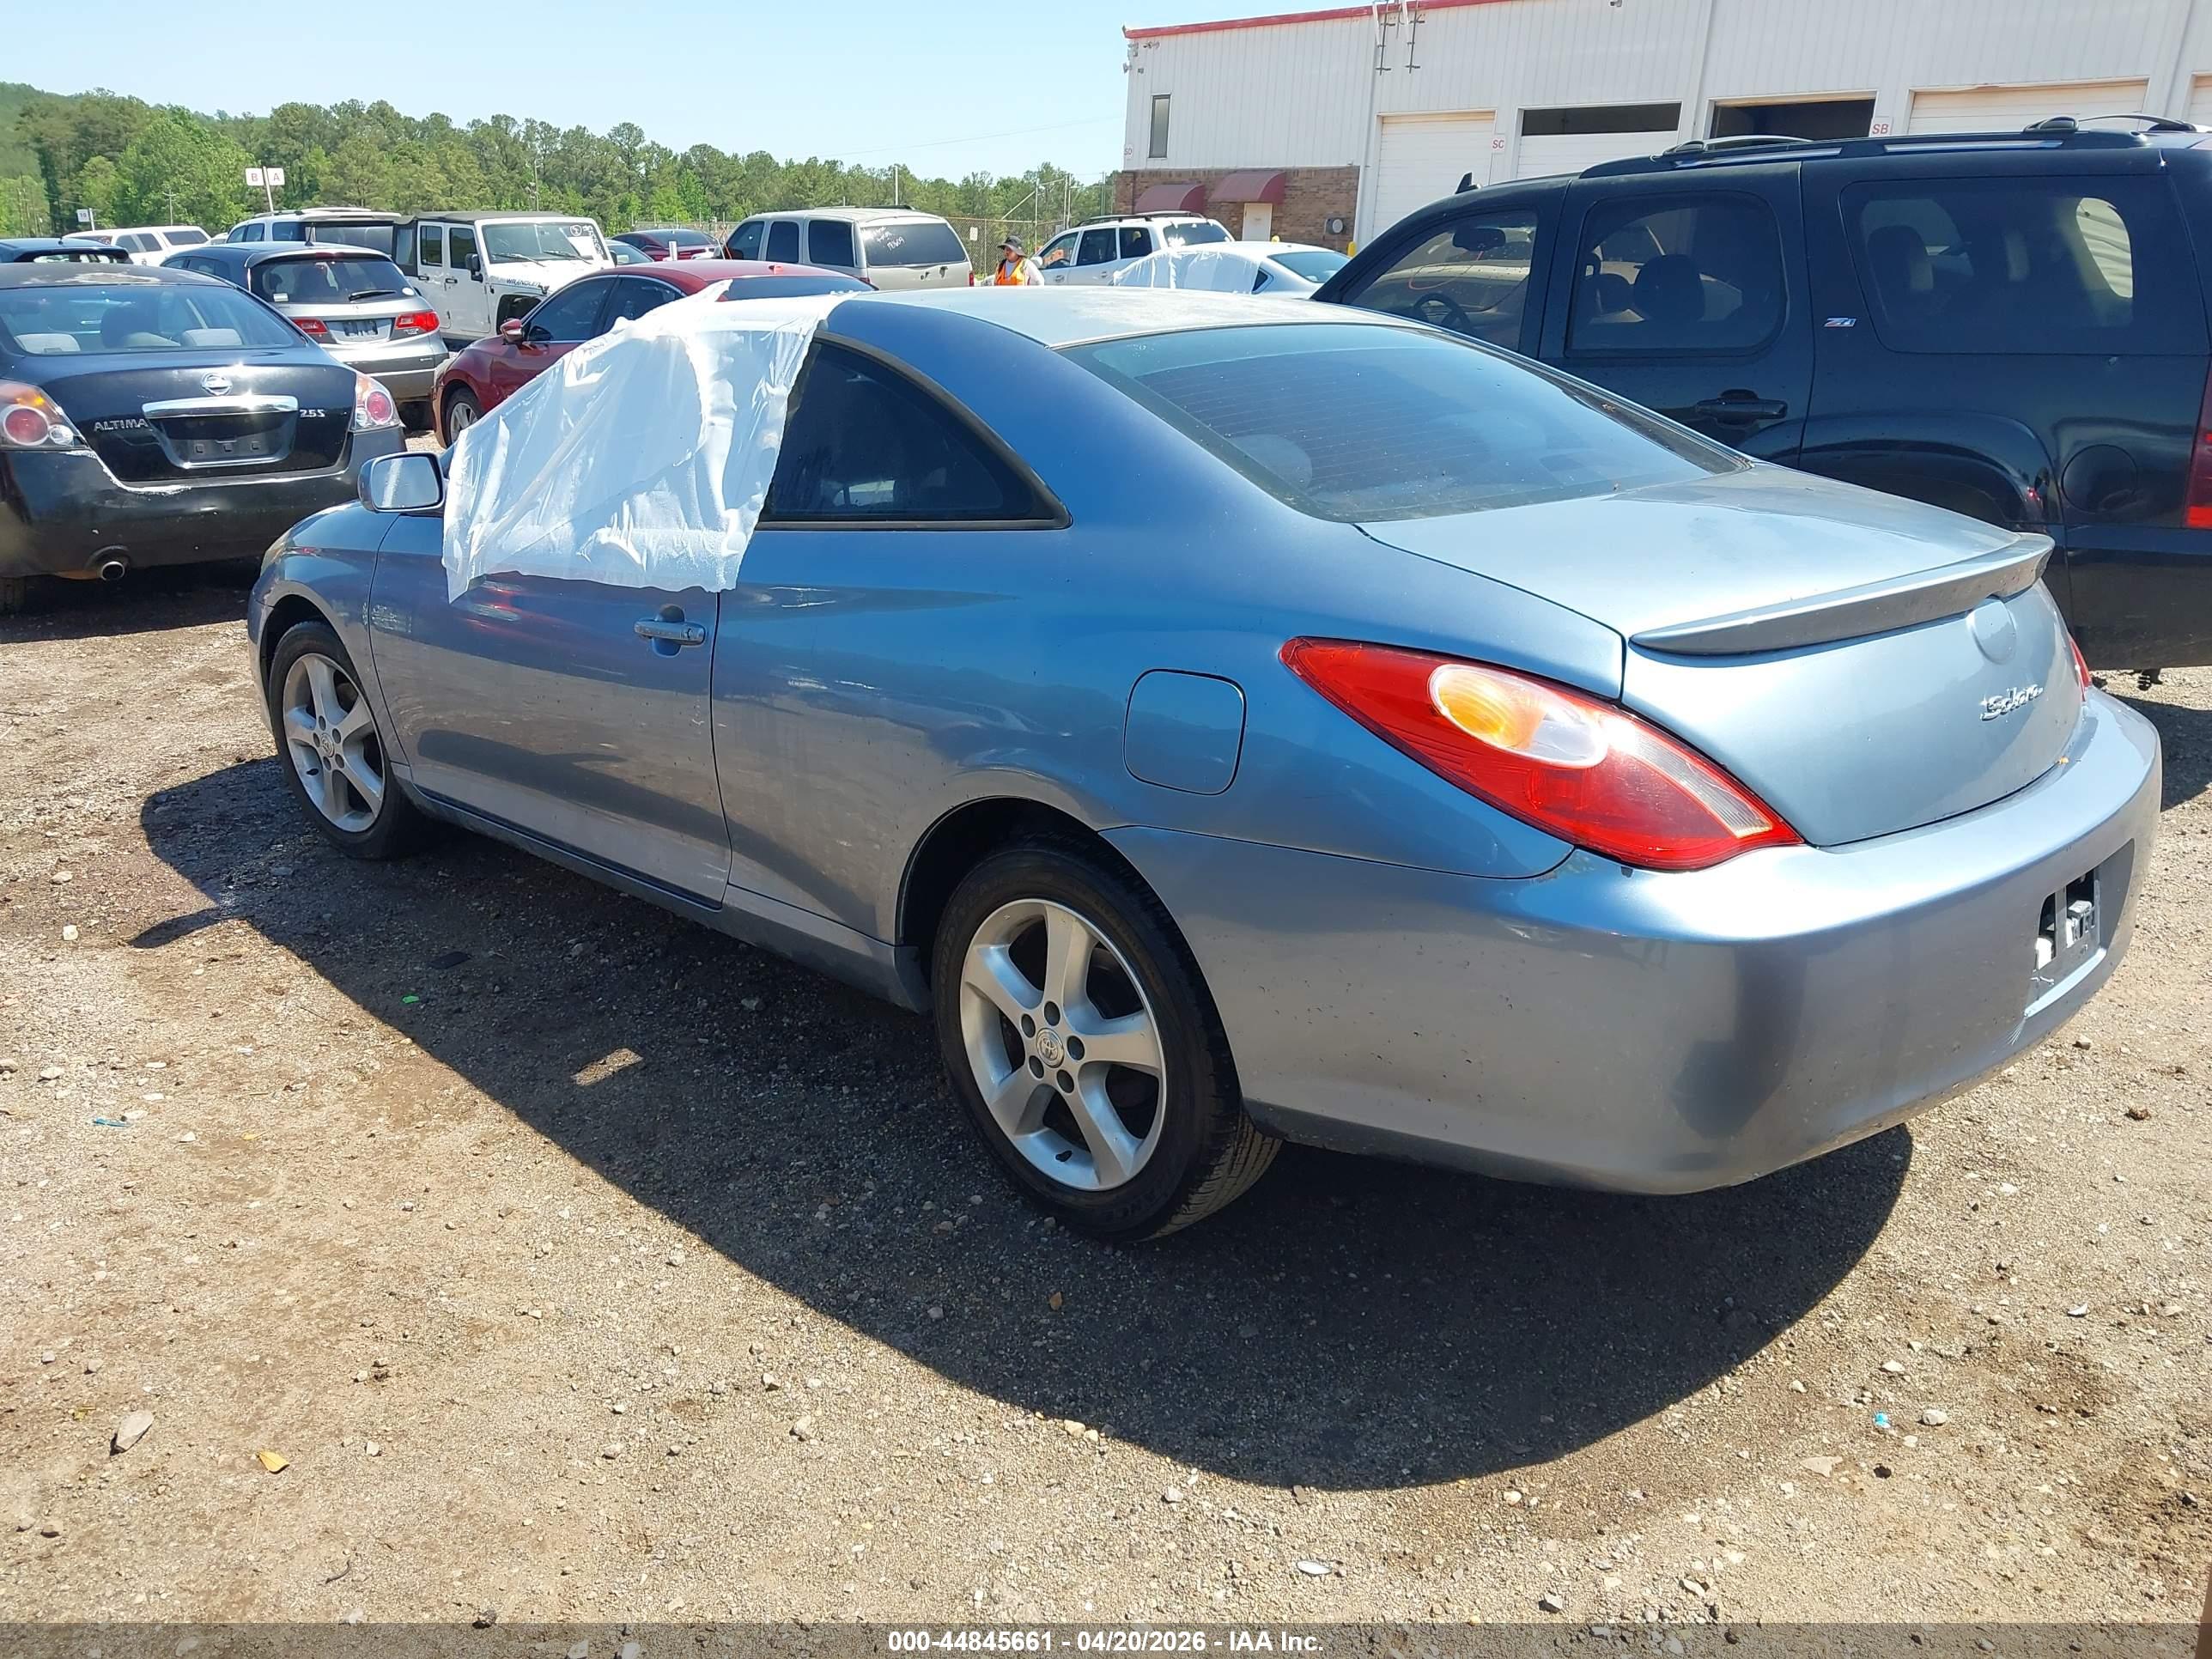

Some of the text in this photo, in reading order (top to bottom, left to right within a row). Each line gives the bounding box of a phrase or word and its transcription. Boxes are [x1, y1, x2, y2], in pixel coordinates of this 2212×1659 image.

[1872, 123, 1888, 135] SB
[1492, 139, 1504, 149] SC
[251, 173, 258, 182] B
[272, 173, 281, 182] A
[507, 278, 541, 287] WRANGLER
[94, 417, 149, 431] ALTIMA
